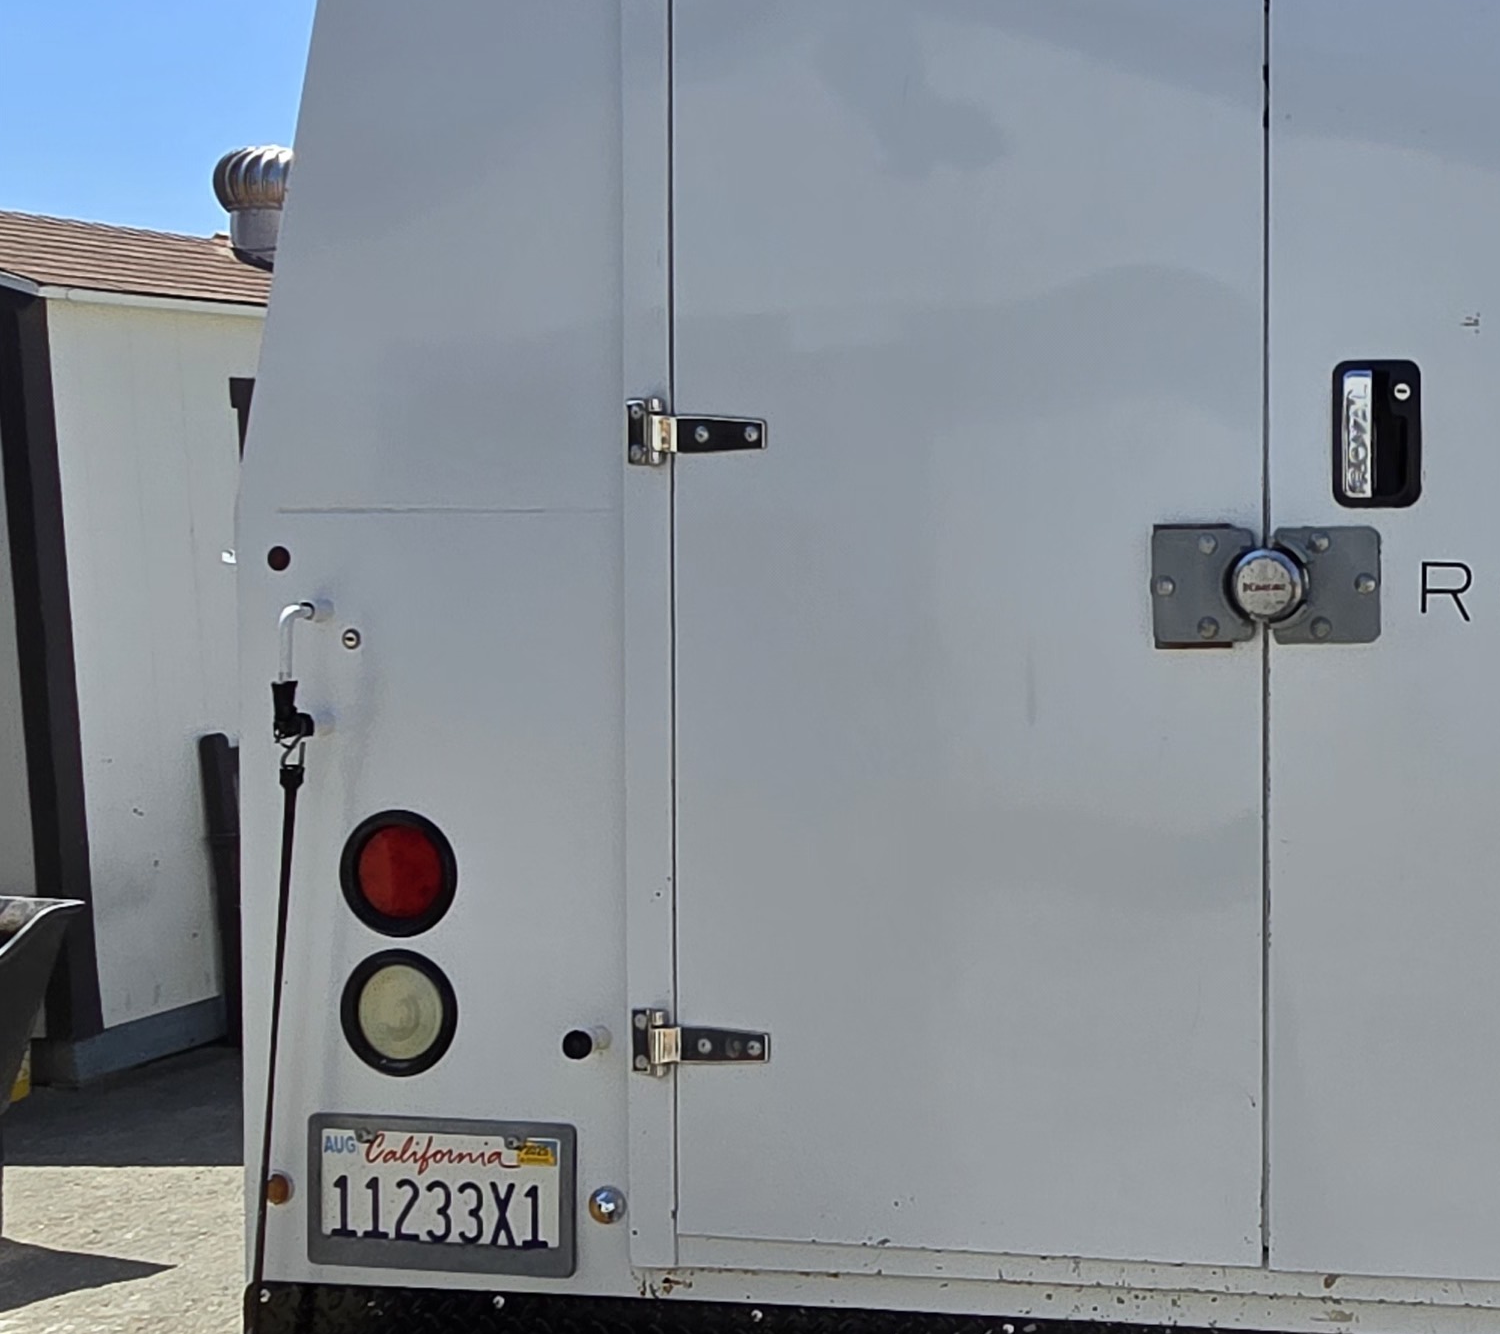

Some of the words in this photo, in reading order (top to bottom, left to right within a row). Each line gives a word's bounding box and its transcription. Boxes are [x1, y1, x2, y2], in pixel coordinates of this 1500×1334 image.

[323, 1134, 357, 1154] AUG
[364, 1132, 521, 1175] California
[330, 1174, 549, 1250] 11233X1
